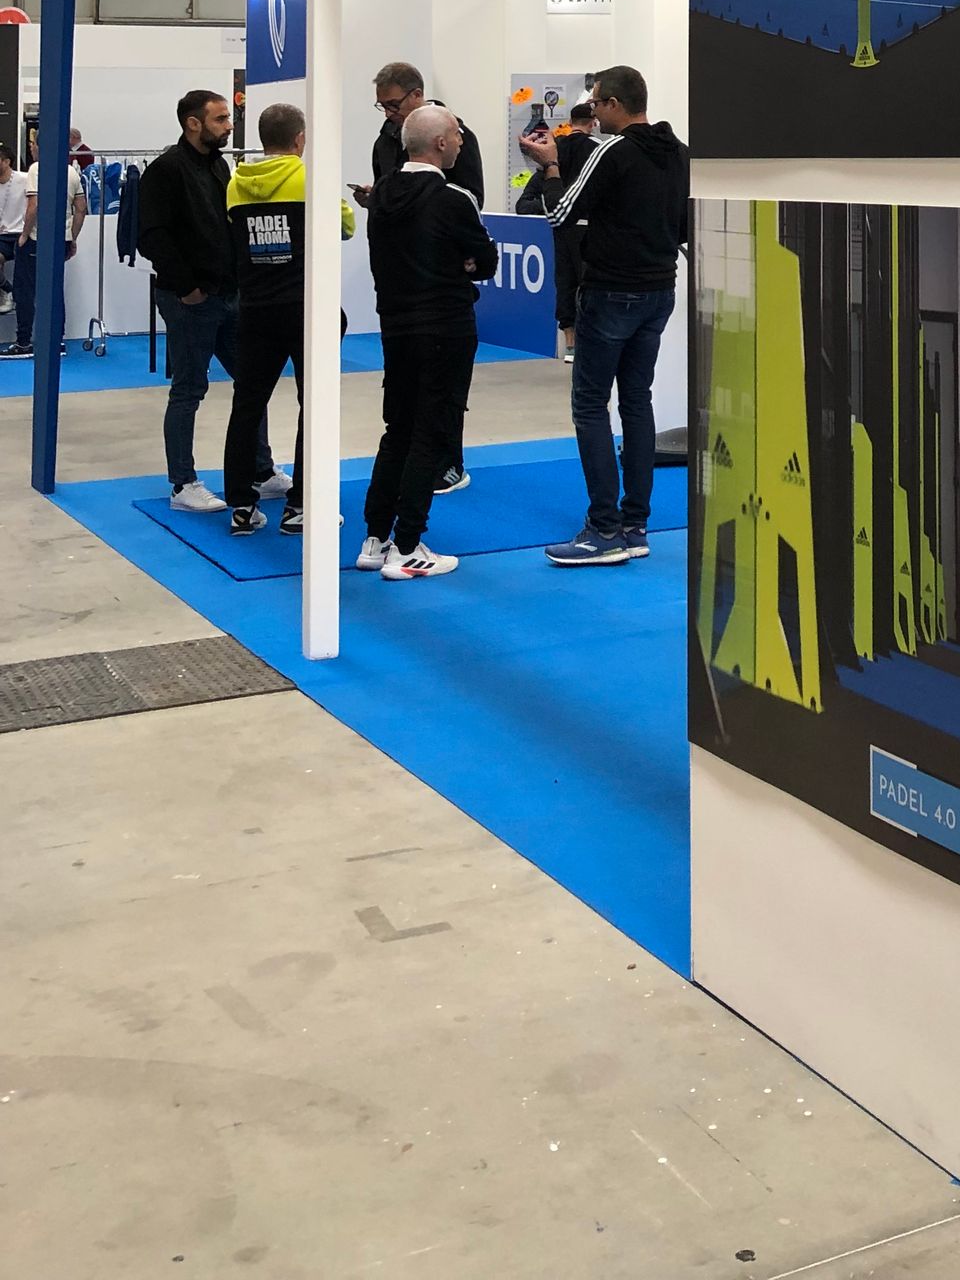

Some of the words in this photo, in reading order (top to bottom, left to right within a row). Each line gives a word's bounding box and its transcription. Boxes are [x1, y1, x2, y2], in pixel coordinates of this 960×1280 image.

[246, 214, 291, 233] PADEL
[248, 232, 256, 246] A
[256, 230, 292, 245] ROMA
[879, 774, 928, 818] PADEL
[934, 804, 956, 830] 4.0
